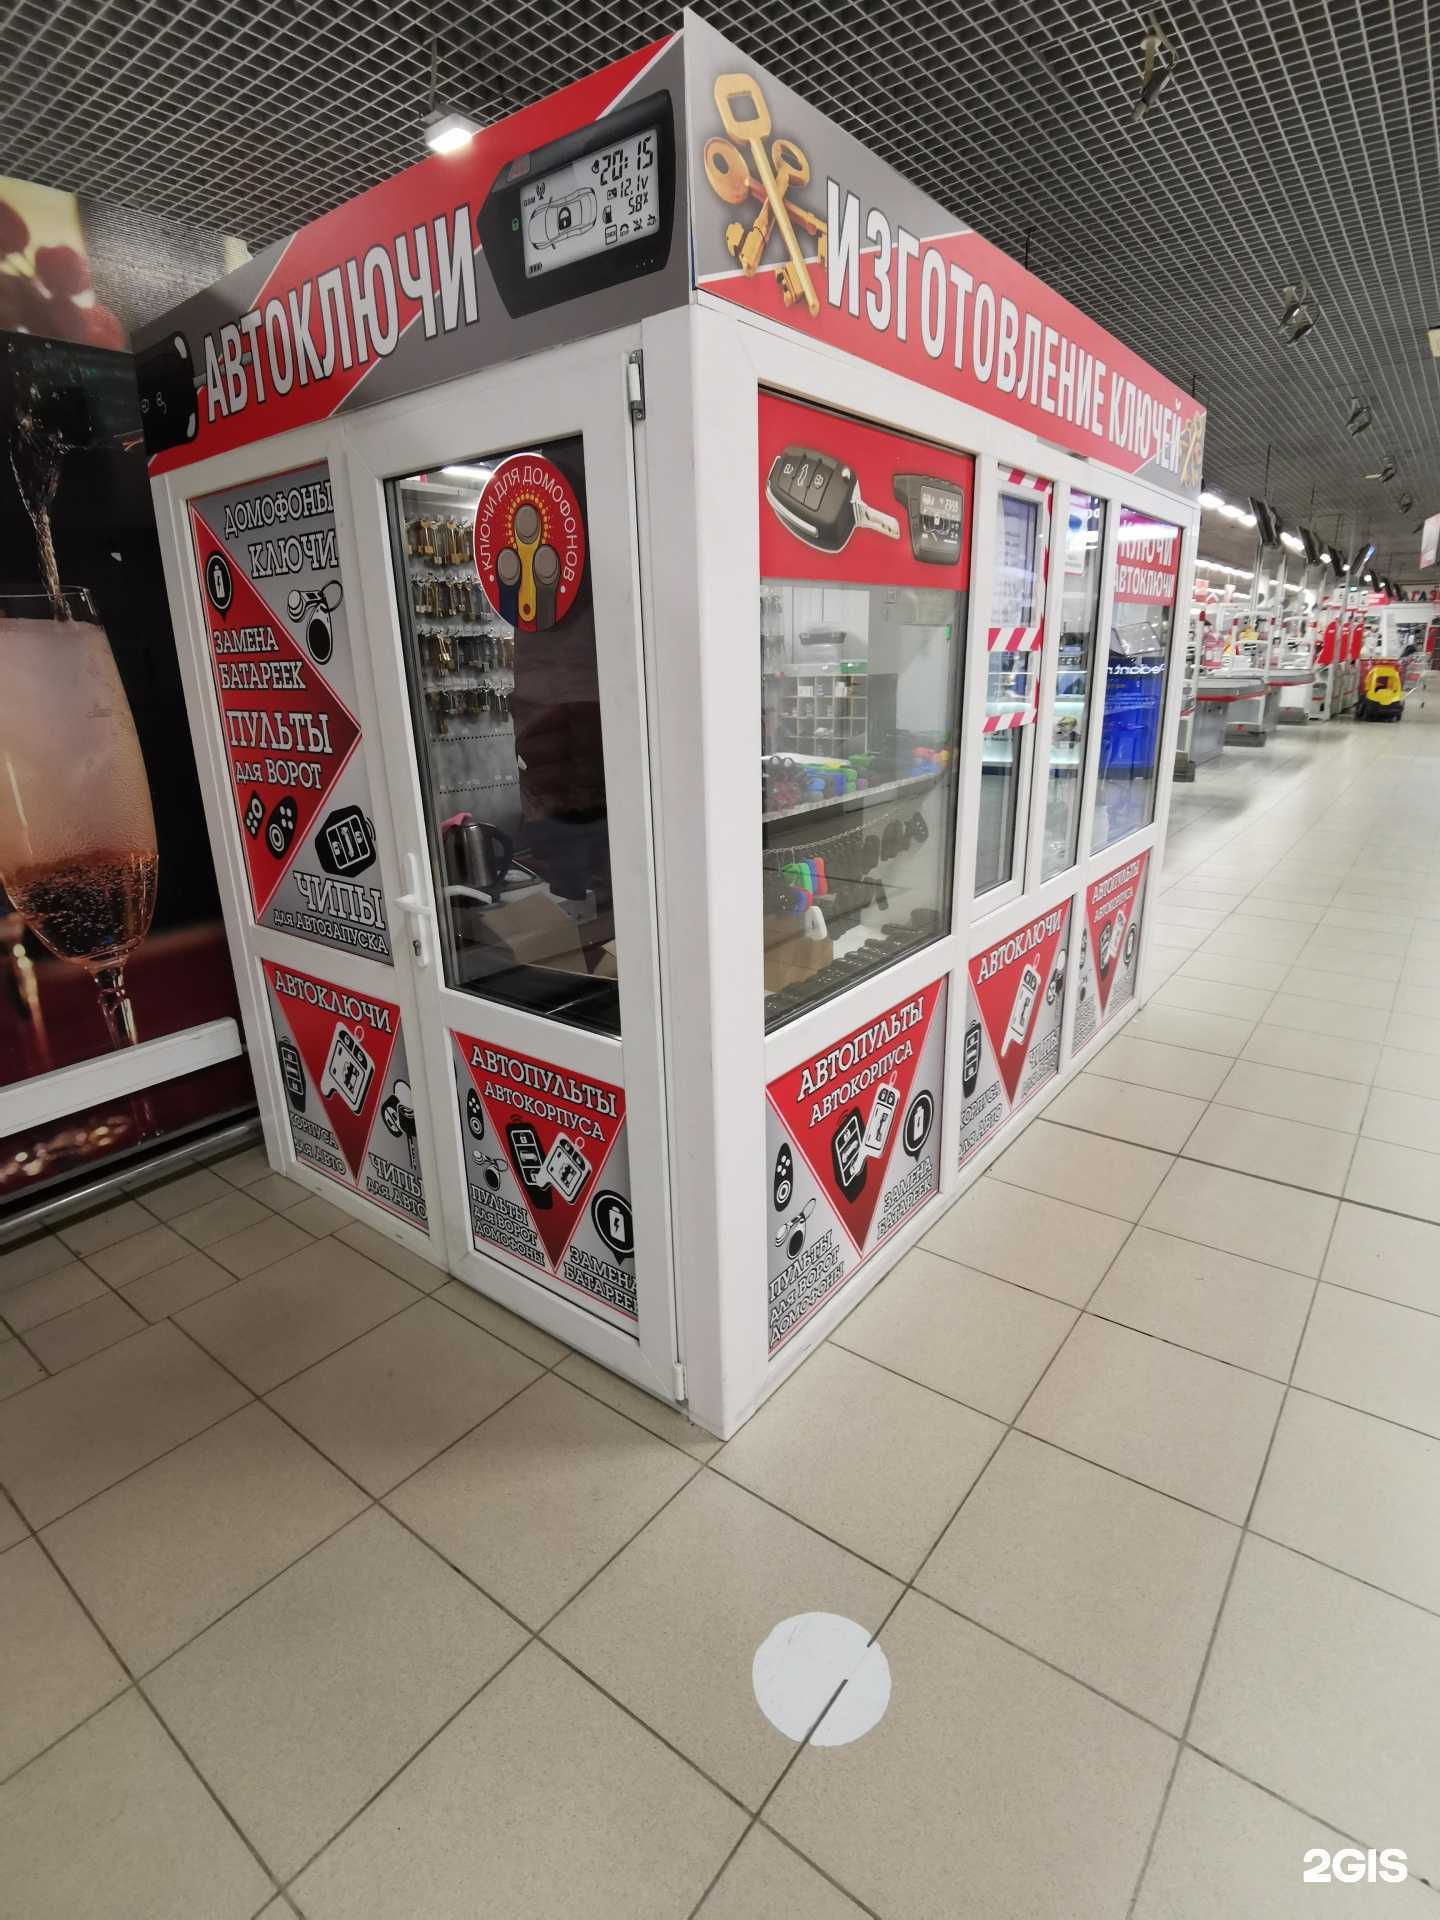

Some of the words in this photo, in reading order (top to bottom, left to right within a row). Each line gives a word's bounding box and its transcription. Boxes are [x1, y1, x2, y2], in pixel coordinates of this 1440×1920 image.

[599, 135, 654, 187] 20:15
[203, 204, 480, 422] АВТОКЛЮЧИ
[826, 177, 1106, 437] ИЗГОТОВЛЕНИЕ
[1108, 371, 1182, 474] КЛЮЧЕЙ
[224, 479, 335, 539] ДОМОФОНЫ
[480, 495, 498, 571] КЛЮЧИ
[494, 466, 520, 497] ДЛЯ
[522, 465, 578, 582] ДОМОФОНОВ
[248, 528, 339, 580] КЛЮЧИ
[213, 626, 279, 655] ЗАМЕНА
[218, 660, 306, 690] БАТАРЕЕК
[226, 710, 334, 754] ПУЛЬТЫ
[265, 757, 322, 790] ВОРОТ
[293, 871, 387, 930] ЧИПЫ
[296, 911, 389, 956] АВТОЗАПУСКА
[976, 909, 1062, 986] АВТОКЛЮЧИ
[274, 969, 393, 1033] АВТОКЛЮЧИ
[796, 997, 925, 1103] АВТОПУЛЬТЫ
[471, 1044, 618, 1119] АВТОПУЛЬТЫ
[484, 1080, 606, 1142] АВТОКОРПУСА
[809, 1039, 914, 1128] АВТОКОРПУСА
[470, 1182, 529, 1227] ПУЛЬТЫ
[495, 1212, 537, 1247] ВОРОТ
[475, 1220, 546, 1267] ДОМОФОНЫ
[769, 1229, 832, 1302] ПУЛЬТЫ
[797, 1245, 840, 1298] ВОРОТ
[564, 1264, 638, 1316] БАТАРЕЕ
[770, 1261, 845, 1346] ДОМОФОНЫ
